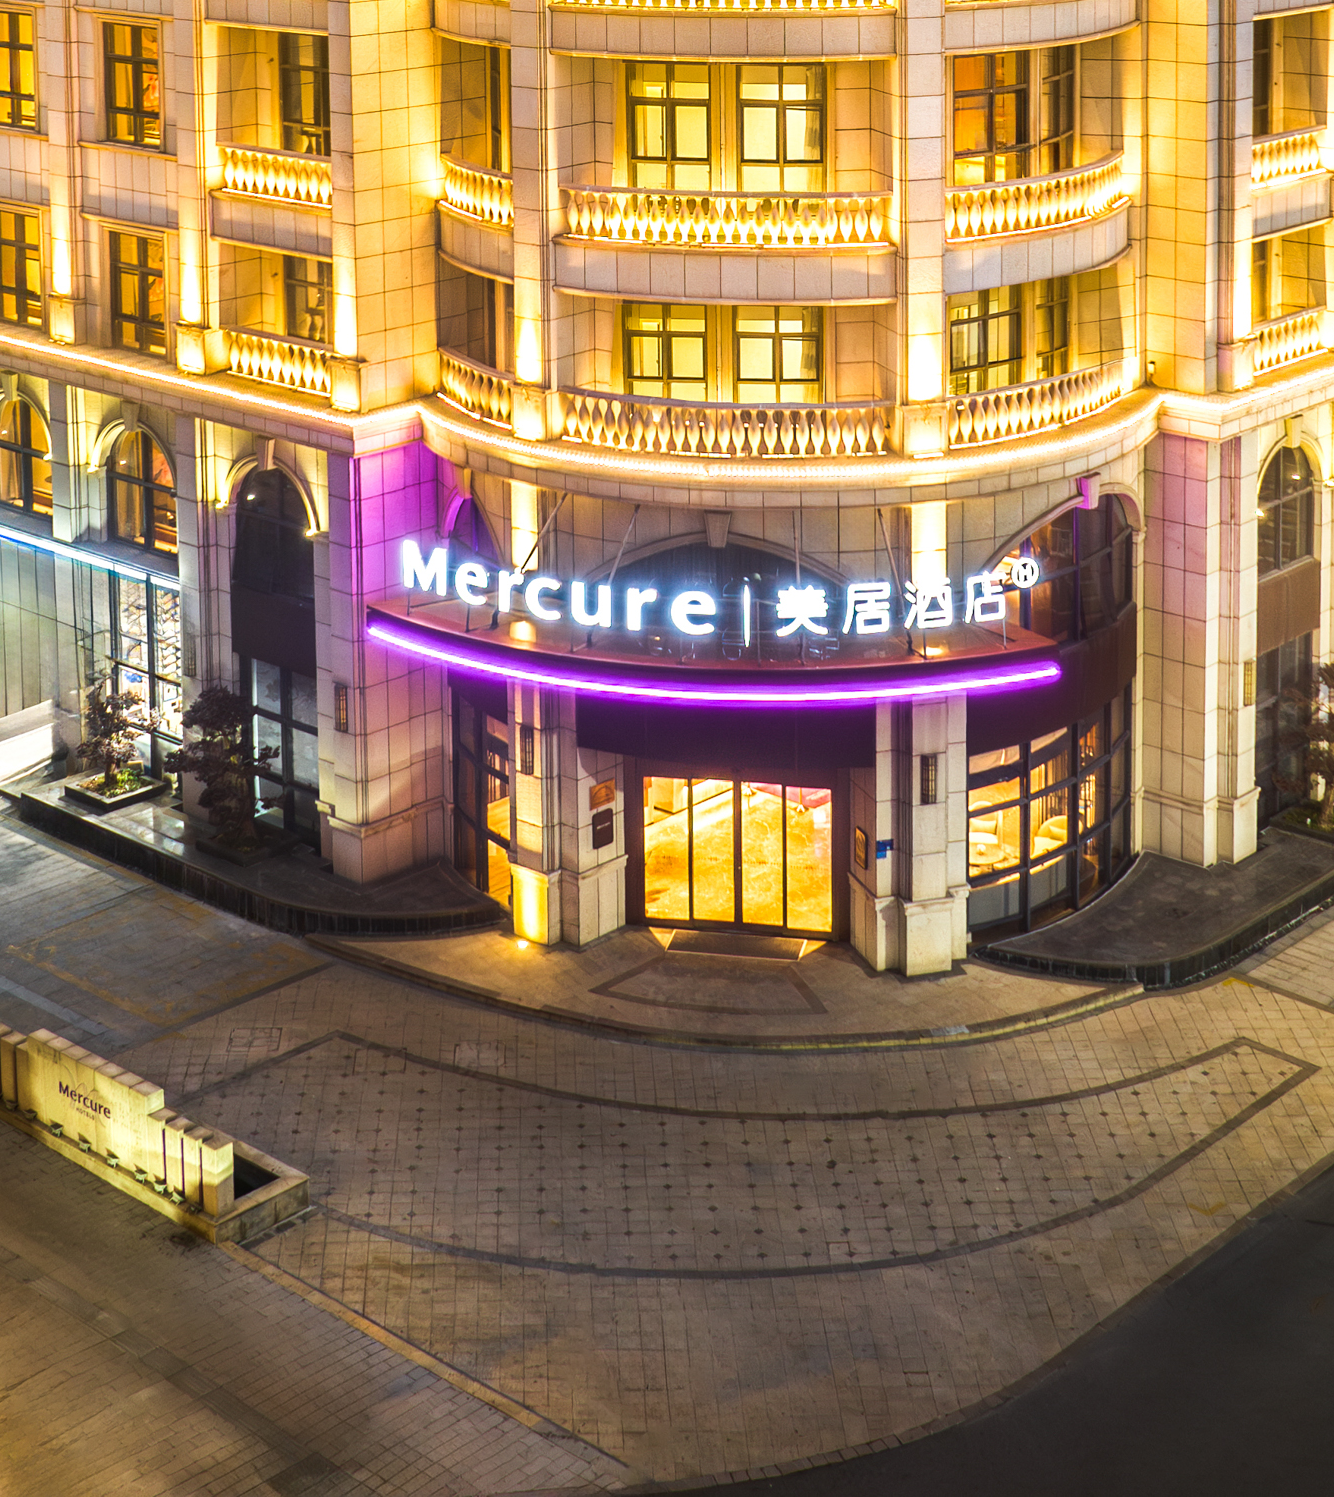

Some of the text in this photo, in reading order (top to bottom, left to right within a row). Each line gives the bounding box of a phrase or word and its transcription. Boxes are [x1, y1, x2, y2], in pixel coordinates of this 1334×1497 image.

[402, 539, 717, 636] Mercure
[776, 571, 1008, 637] 美居酒店
[59, 1080, 111, 1119] Mercure
